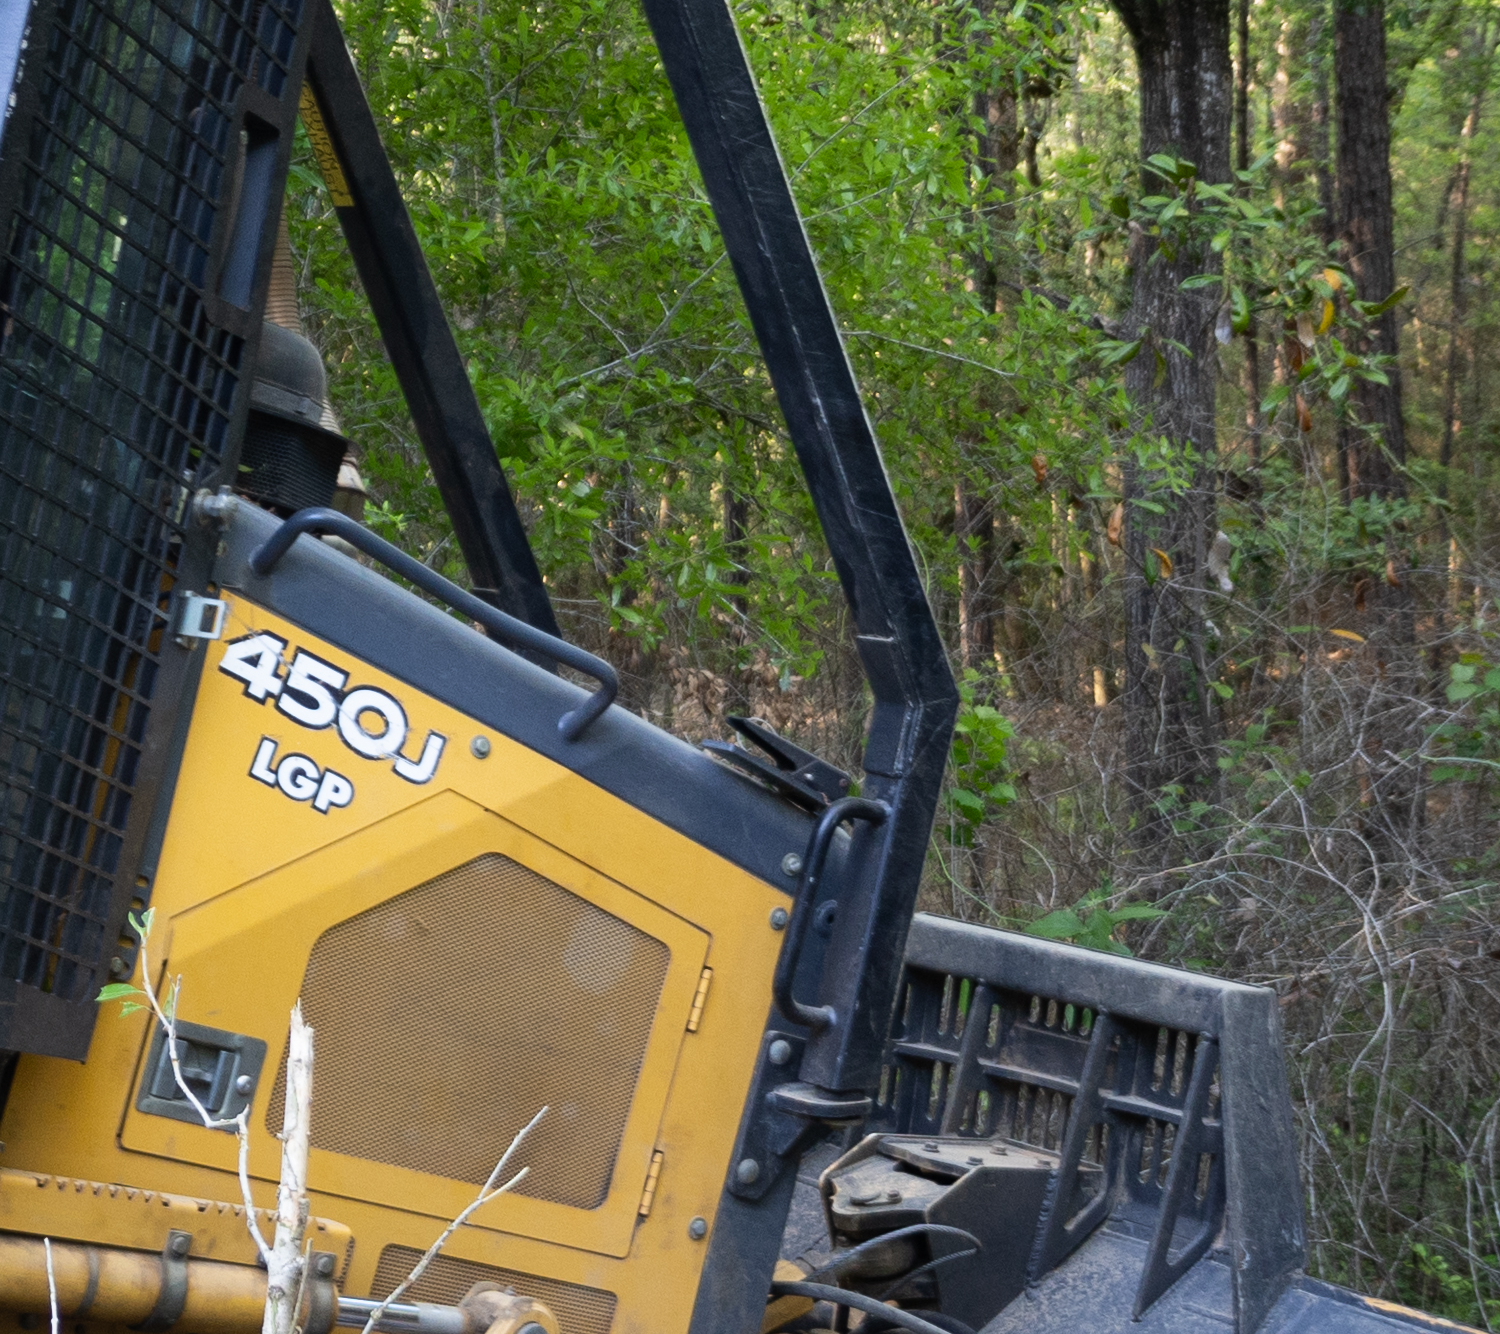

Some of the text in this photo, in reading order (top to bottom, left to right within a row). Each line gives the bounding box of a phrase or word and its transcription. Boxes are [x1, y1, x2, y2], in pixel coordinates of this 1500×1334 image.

[300, 107, 346, 197] EXHAUST
[218, 629, 447, 785] 450J
[248, 734, 354, 815] LGP
